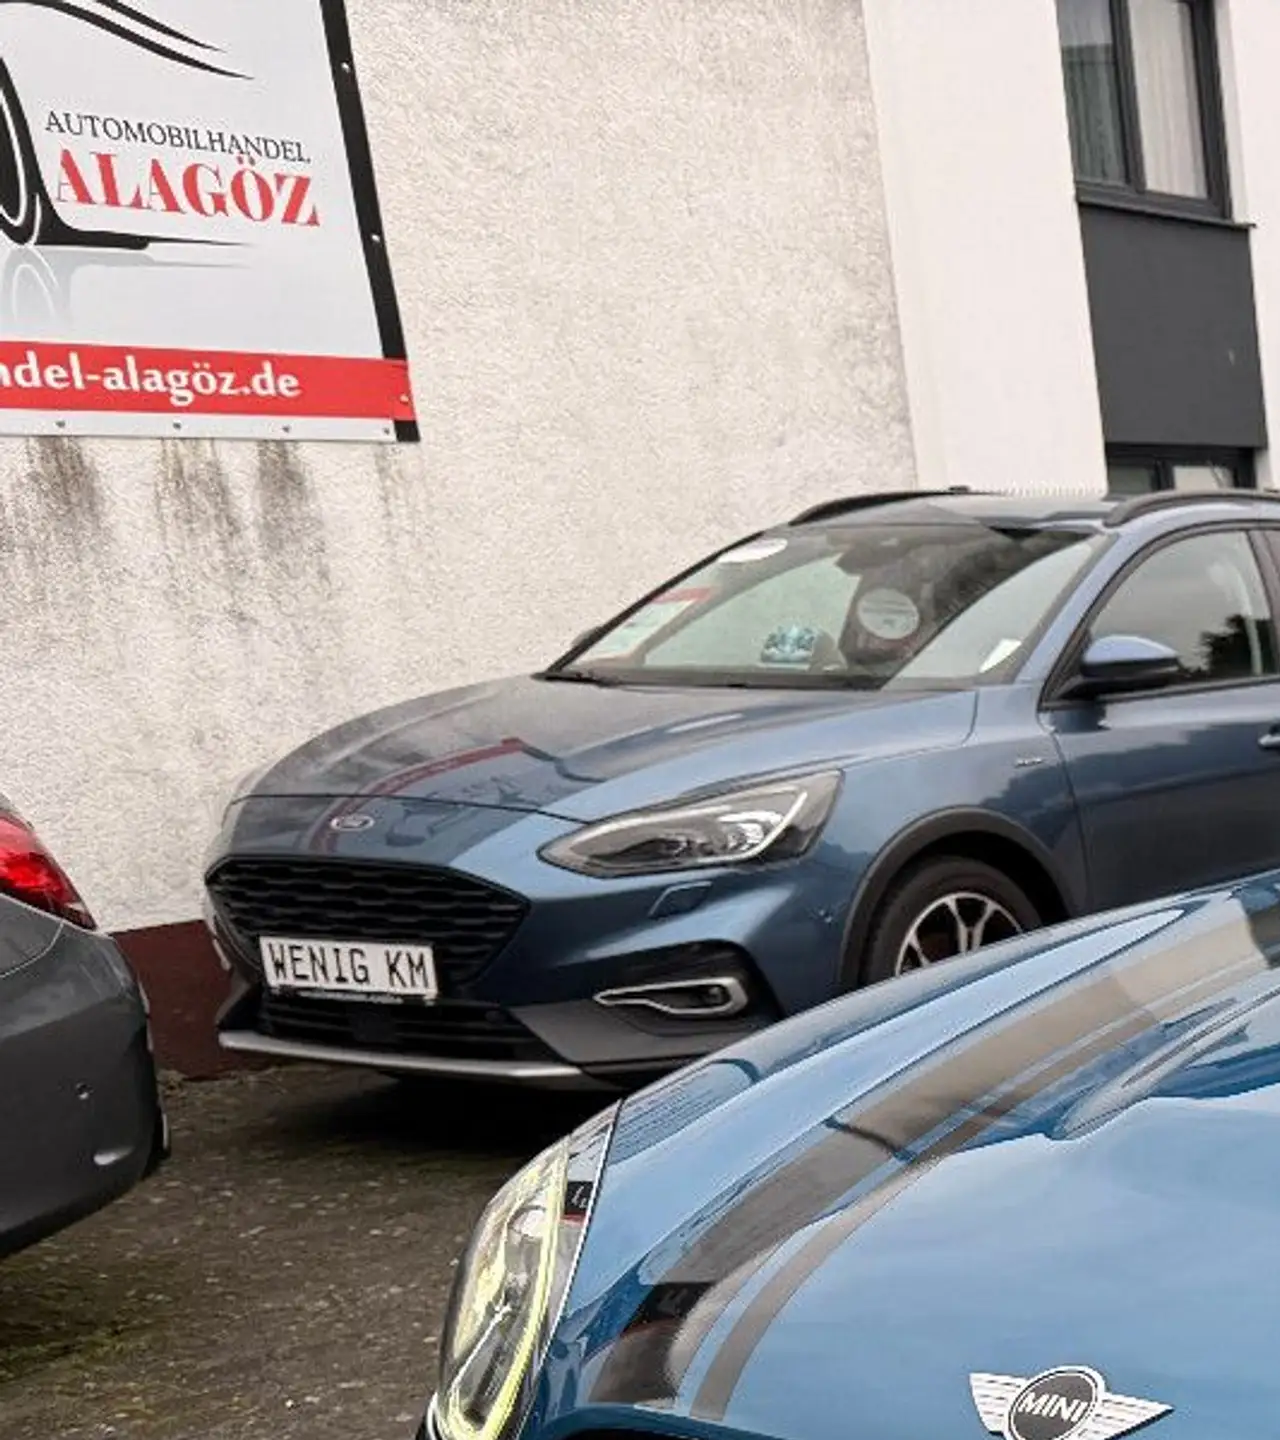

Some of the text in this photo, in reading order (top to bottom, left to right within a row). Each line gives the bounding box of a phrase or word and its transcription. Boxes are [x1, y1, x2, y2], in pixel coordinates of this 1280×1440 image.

[45, 110, 311, 163] AUTOMOBILHANDEL
[56, 148, 320, 227] ALAGÖZ
[268, 942, 429, 988] WENIG KM
[1018, 1392, 1088, 1422] MINI
